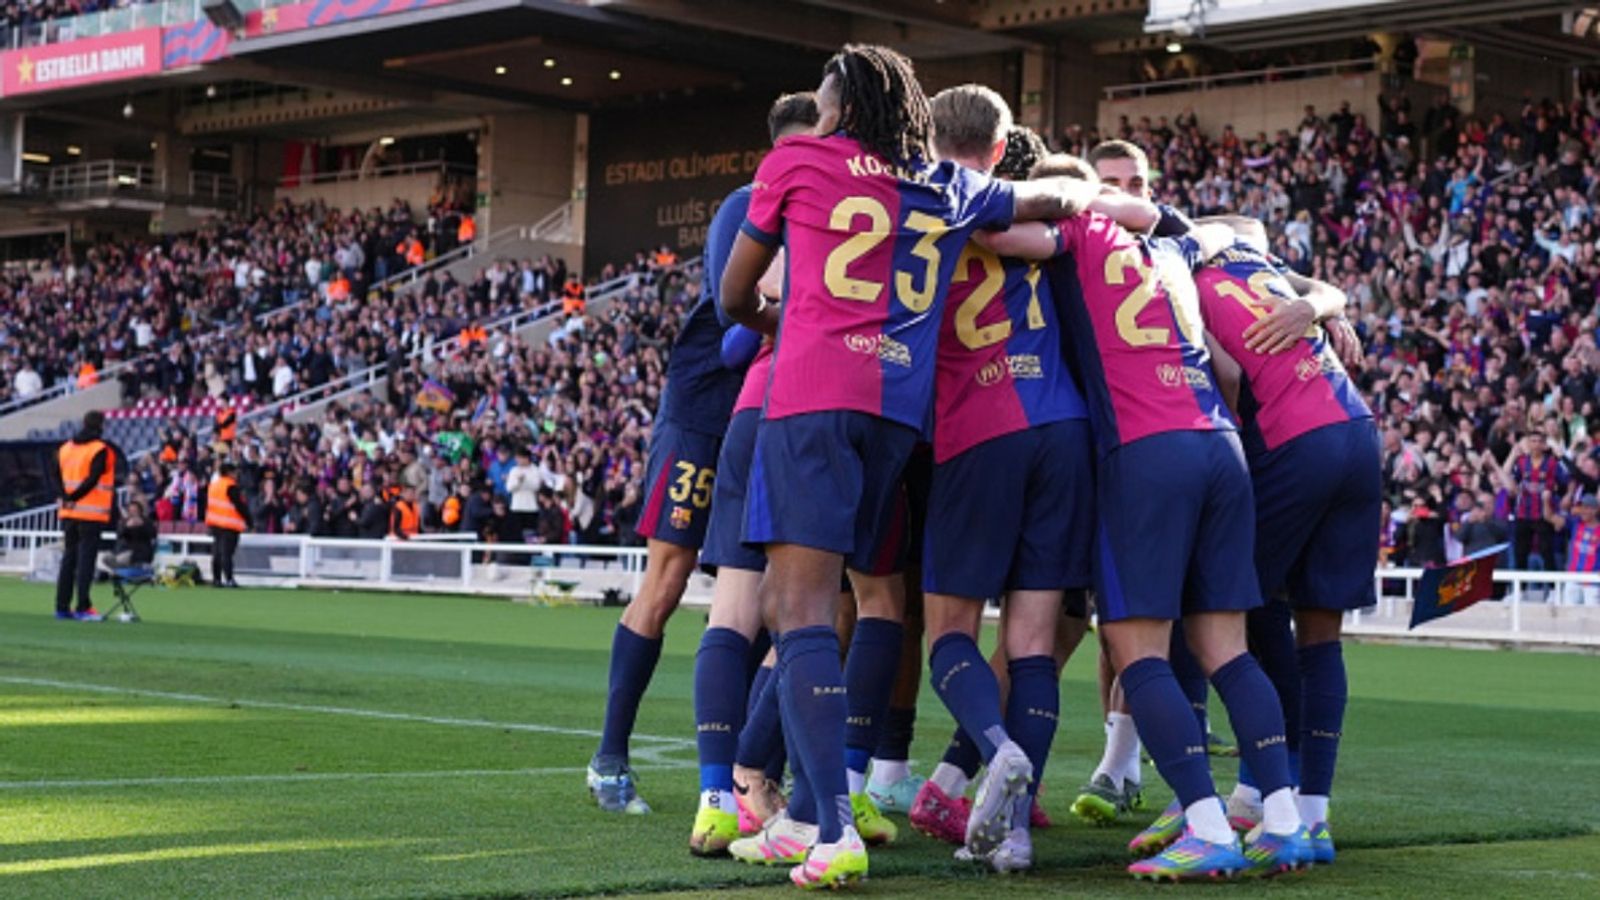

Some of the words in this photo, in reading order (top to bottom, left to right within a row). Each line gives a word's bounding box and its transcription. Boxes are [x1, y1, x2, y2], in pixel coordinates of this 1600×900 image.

[35, 51, 98, 82] ESTRELLA
[101, 44, 145, 72] DAMM
[605, 160, 664, 185] ESTADI
[669, 151, 742, 179] OLÍMPIC
[657, 198, 706, 227] LLUÍS
[824, 196, 951, 313] 23
[668, 460, 716, 508] 35
